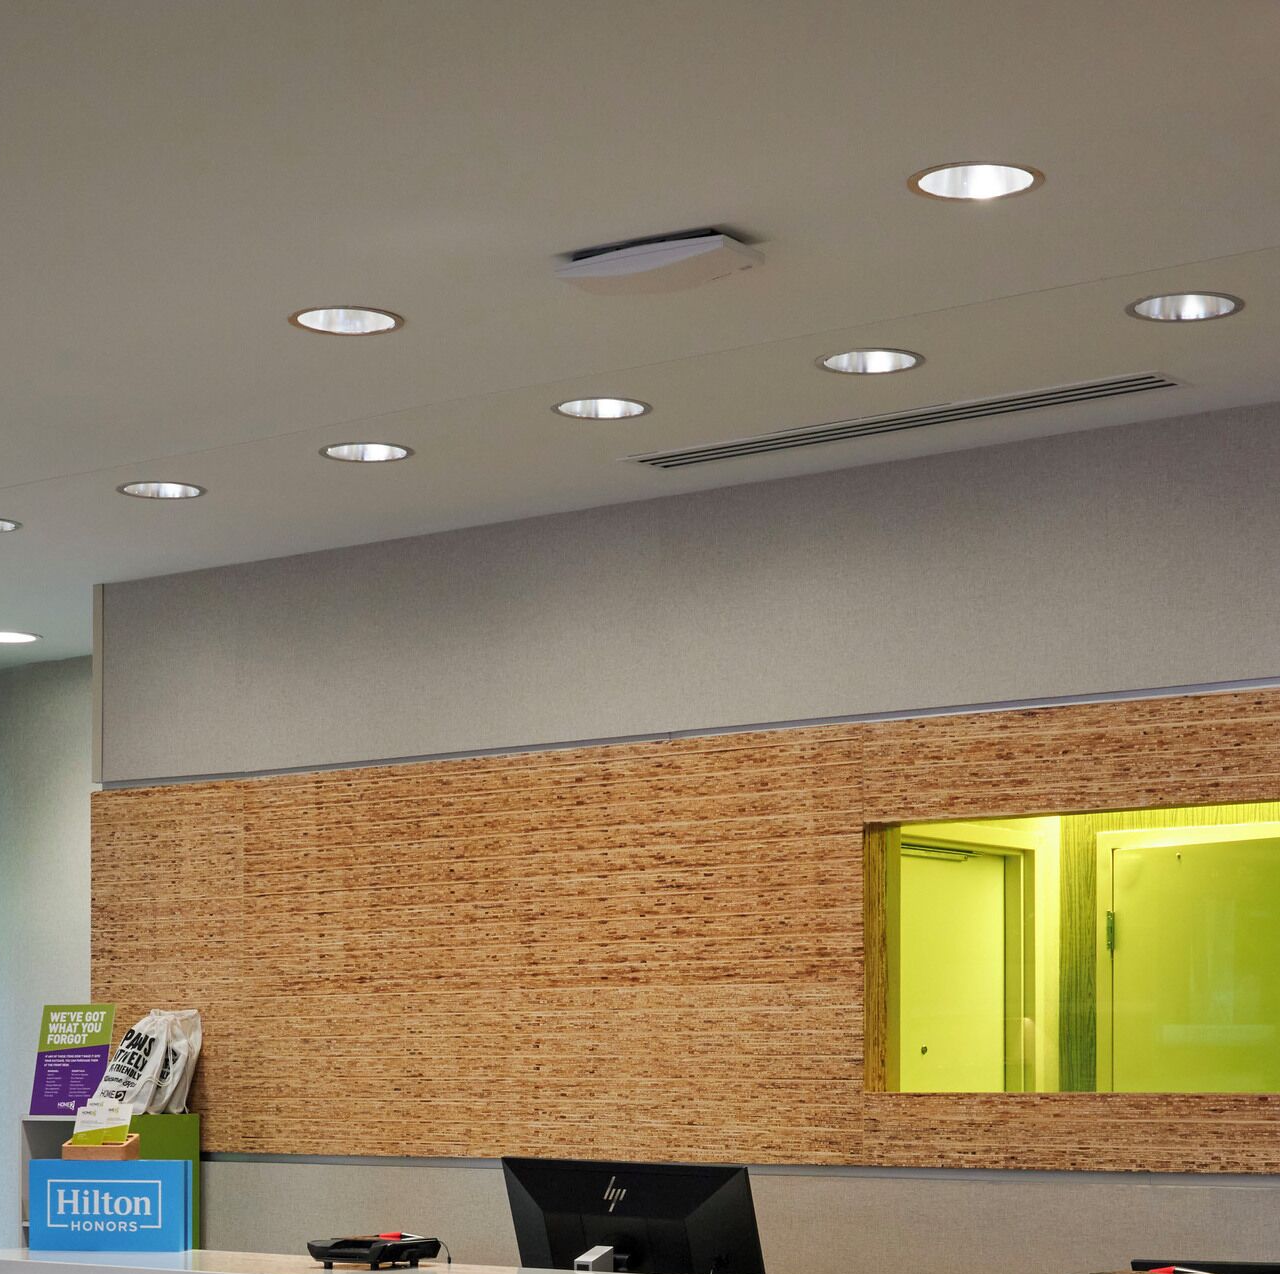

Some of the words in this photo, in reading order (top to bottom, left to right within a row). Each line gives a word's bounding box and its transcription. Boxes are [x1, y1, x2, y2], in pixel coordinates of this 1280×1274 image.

[50, 1011, 83, 1022] WE'VE
[85, 1011, 106, 1022] GOT
[49, 1022, 79, 1033] WHAT
[81, 1022, 102, 1033] YOU
[47, 1033, 88, 1045] FORGOT
[604, 1175, 627, 1212] hp
[56, 1189, 152, 1216] Hilton
[71, 1220, 138, 1232] HONORS
